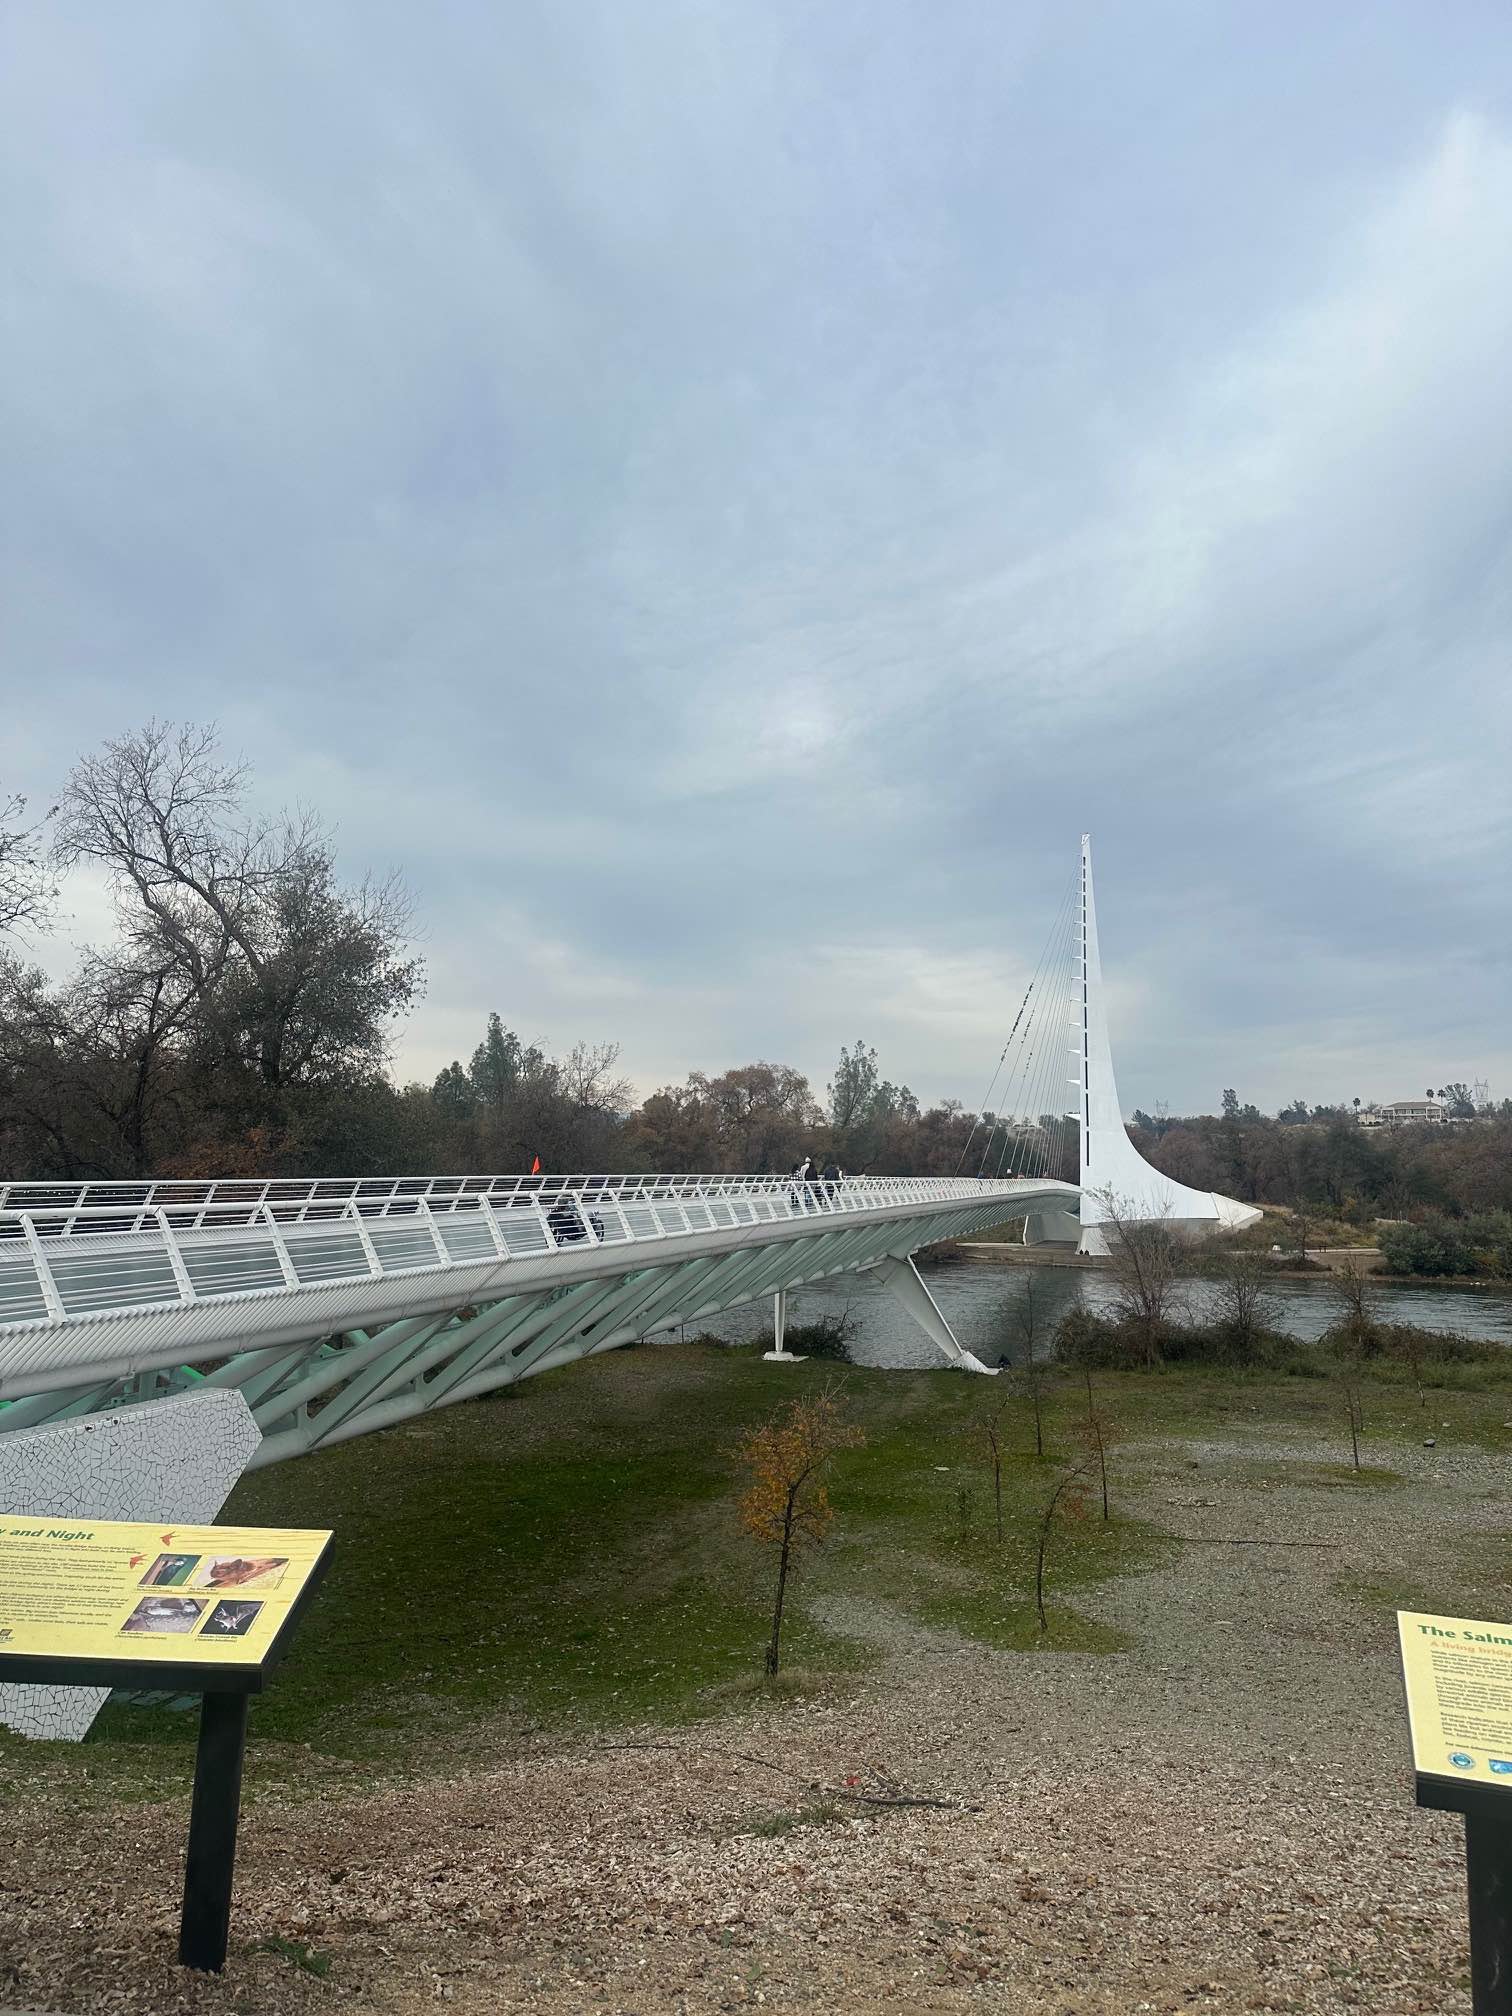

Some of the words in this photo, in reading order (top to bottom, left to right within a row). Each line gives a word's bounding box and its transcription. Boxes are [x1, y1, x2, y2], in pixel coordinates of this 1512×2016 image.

[9, 1529, 45, 1537] and
[46, 1529, 96, 1541] Night
[1417, 1624, 1456, 1638] The
[1462, 1631, 1512, 1645] Salm
